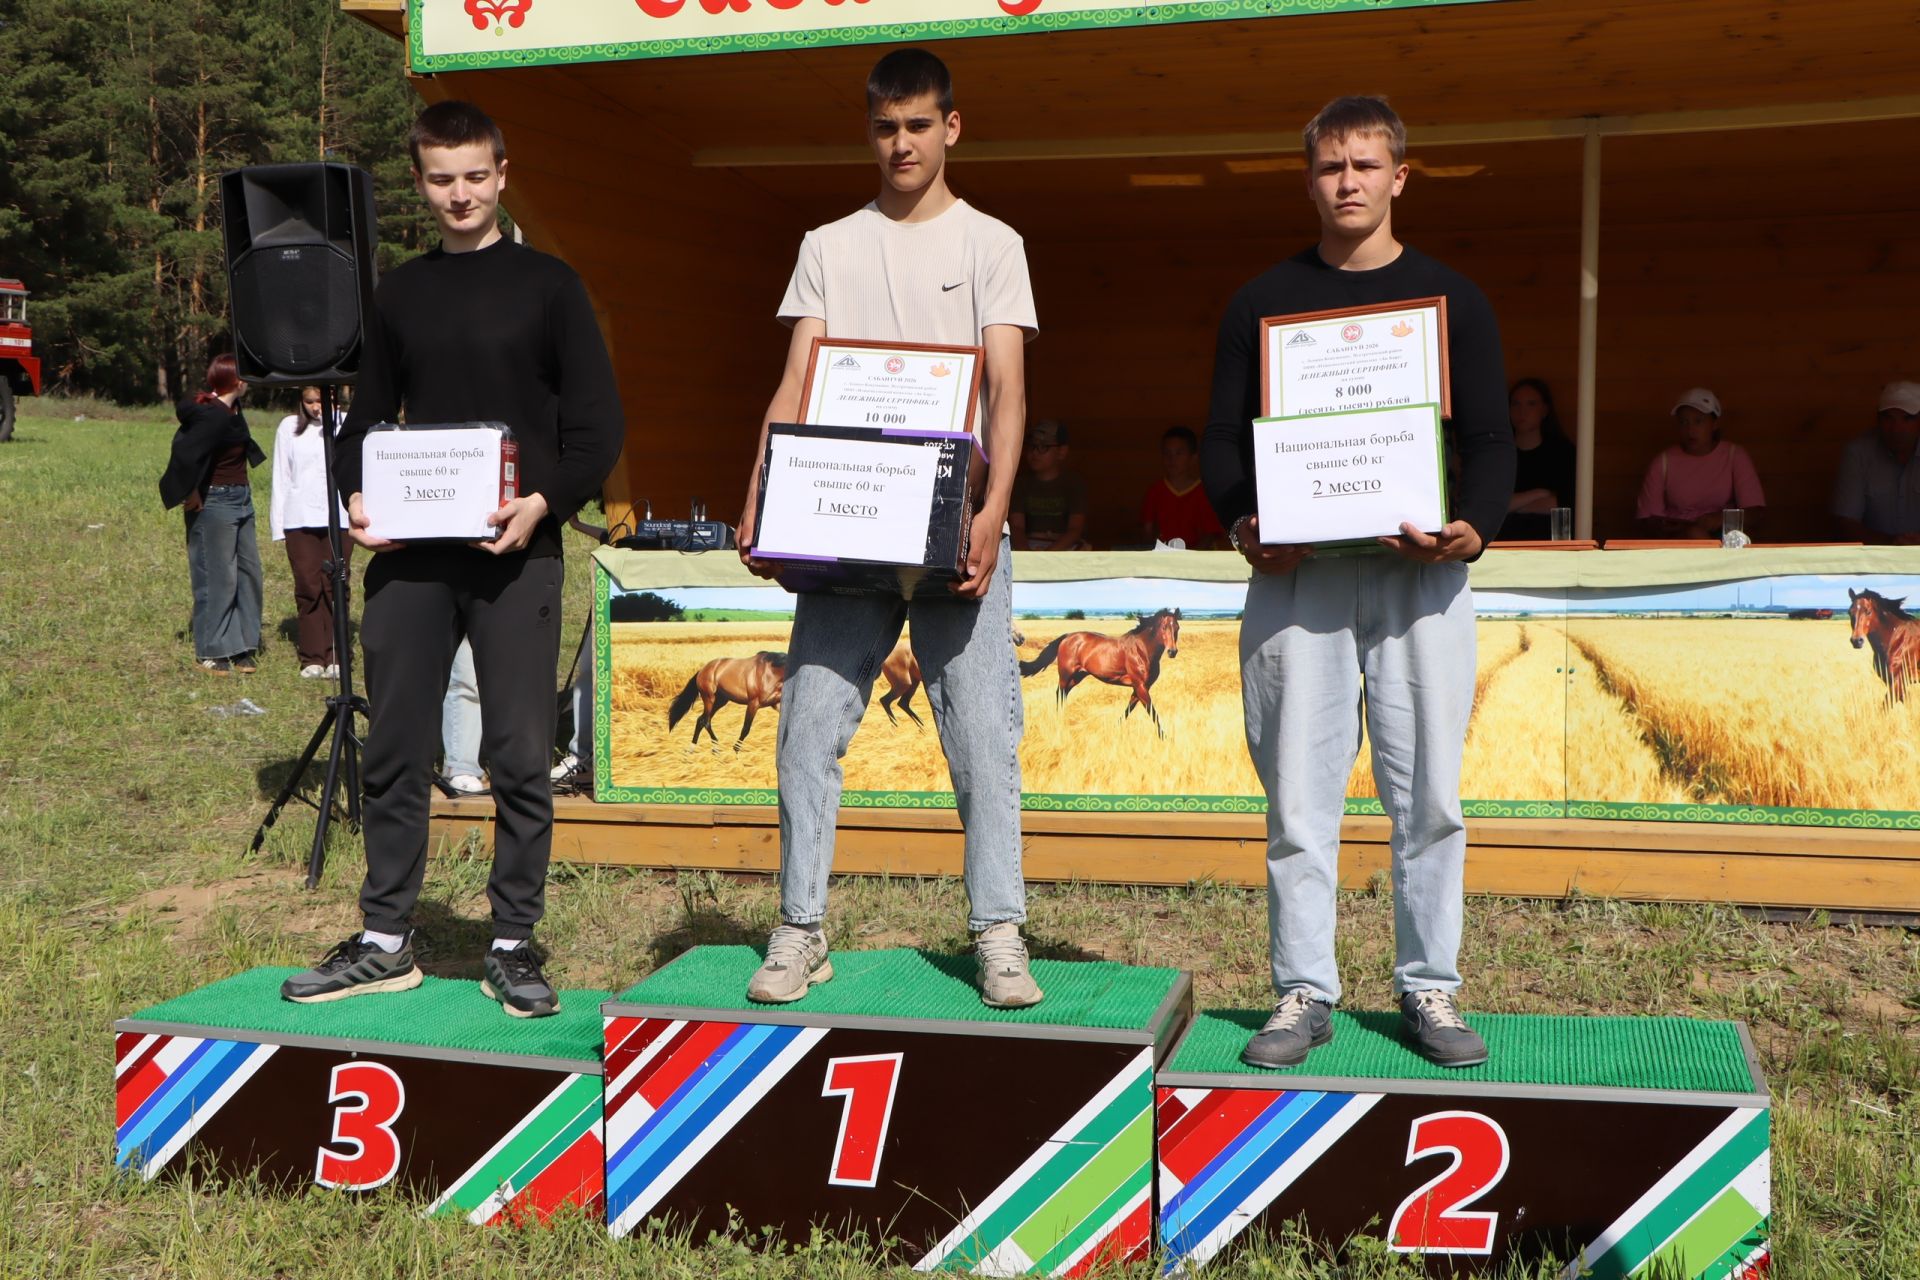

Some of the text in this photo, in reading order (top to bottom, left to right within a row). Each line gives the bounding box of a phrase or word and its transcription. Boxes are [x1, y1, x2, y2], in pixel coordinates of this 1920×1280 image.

[1298, 368, 1350, 381] ДЕНЕЖНЫЙ
[1351, 361, 1408, 375] СЕРТИФИКАТ
[1335, 383, 1372, 398] 8 000
[836, 394, 940, 406] ДЕНЕЖНЫЙ СЕРТИФИКАТ
[1376, 396, 1410, 409] рублей
[865, 412, 906, 424] 10 000
[1275, 430, 1414, 453] Национальная борьба
[376, 448, 484, 461] Национальная борьба
[1306, 454, 1384, 470] свыше 60 кг
[400, 465, 460, 477] свыше 60 кг
[788, 456, 916, 477] Национальная борьба
[404, 485, 456, 500] 3 место
[813, 478, 886, 493] свыше 60 кг
[1312, 479, 1382, 496] 2 место
[816, 497, 878, 517] 1 место
[316, 1061, 405, 1191] 3
[822, 1052, 904, 1188] 1
[1387, 1110, 1510, 1255] 2
